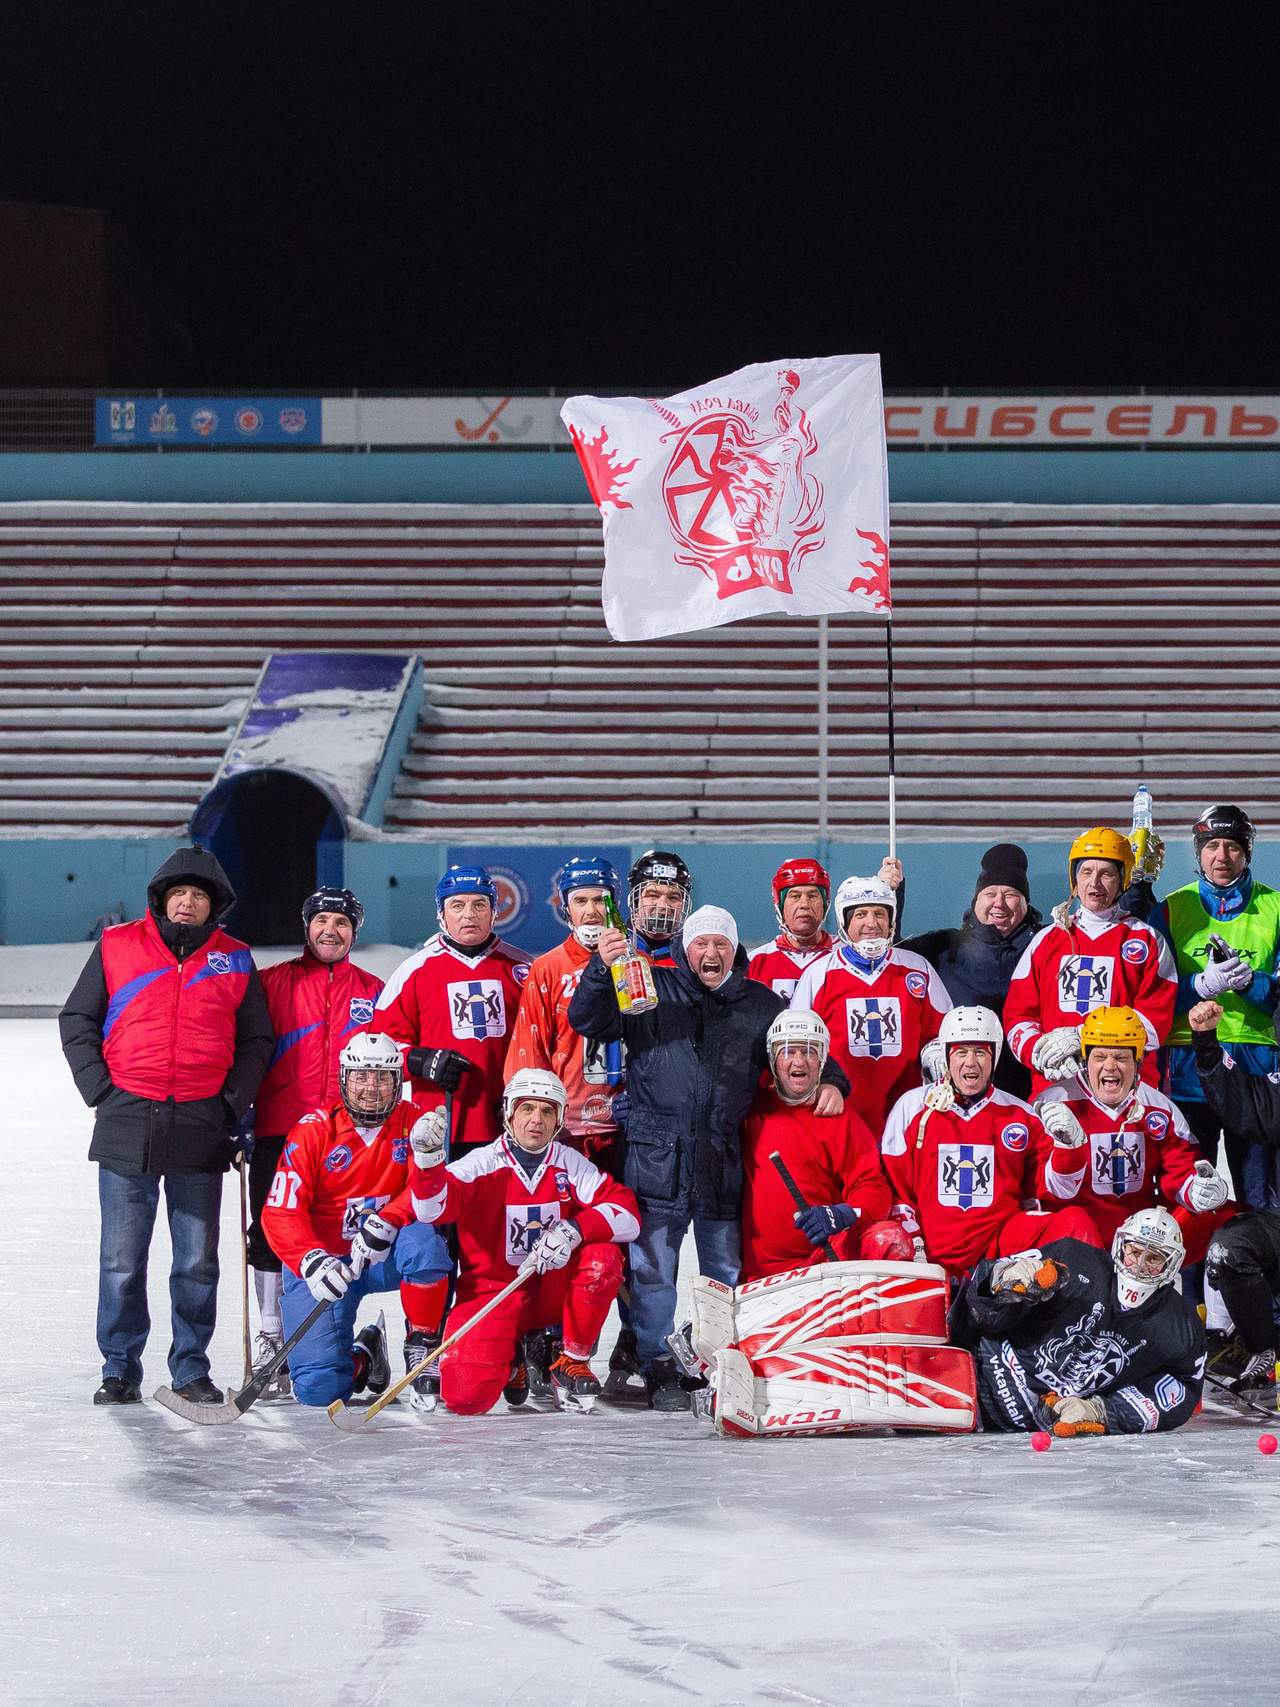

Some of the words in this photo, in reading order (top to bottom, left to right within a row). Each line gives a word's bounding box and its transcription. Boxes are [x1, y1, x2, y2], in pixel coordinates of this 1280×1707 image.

[267, 1171, 302, 1209] 97
[740, 1267, 811, 1296] CCM
[1125, 1288, 1139, 1303] 76
[765, 1408, 842, 1428] CCM
